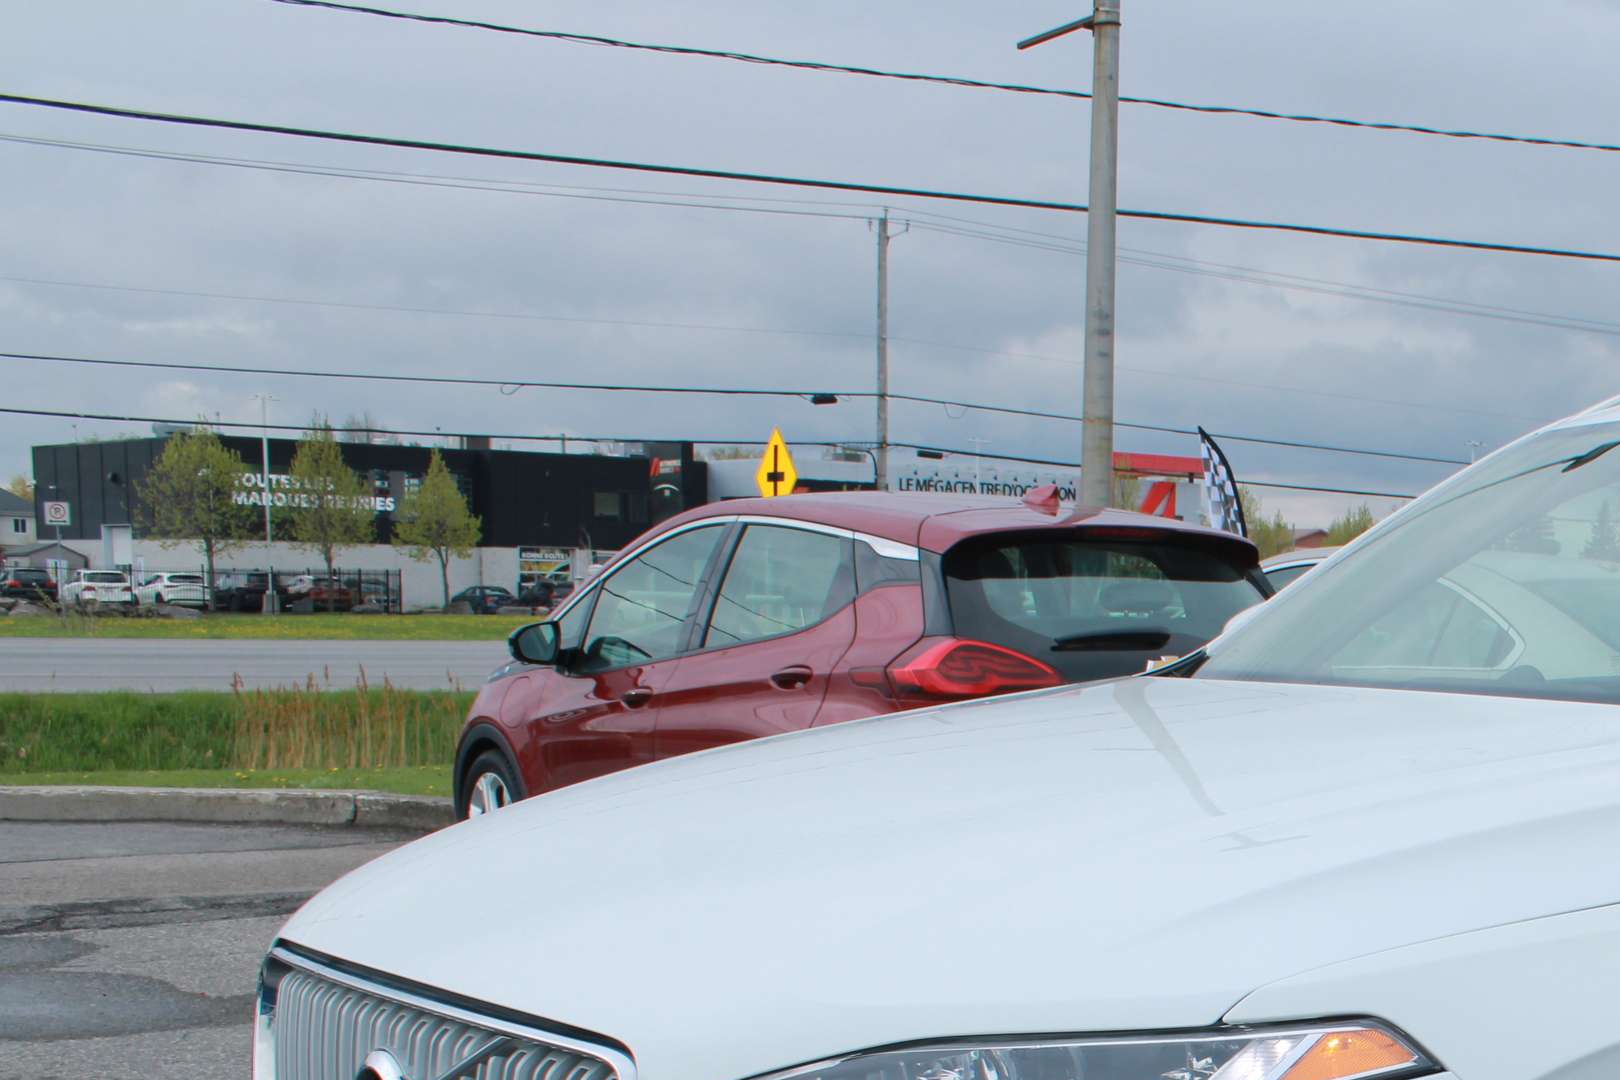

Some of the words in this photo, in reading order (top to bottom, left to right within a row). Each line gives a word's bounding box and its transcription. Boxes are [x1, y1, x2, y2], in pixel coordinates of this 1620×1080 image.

[231, 472, 301, 489] TOUTES
[898, 477, 914, 492] LE
[231, 490, 320, 509] MARQUES
